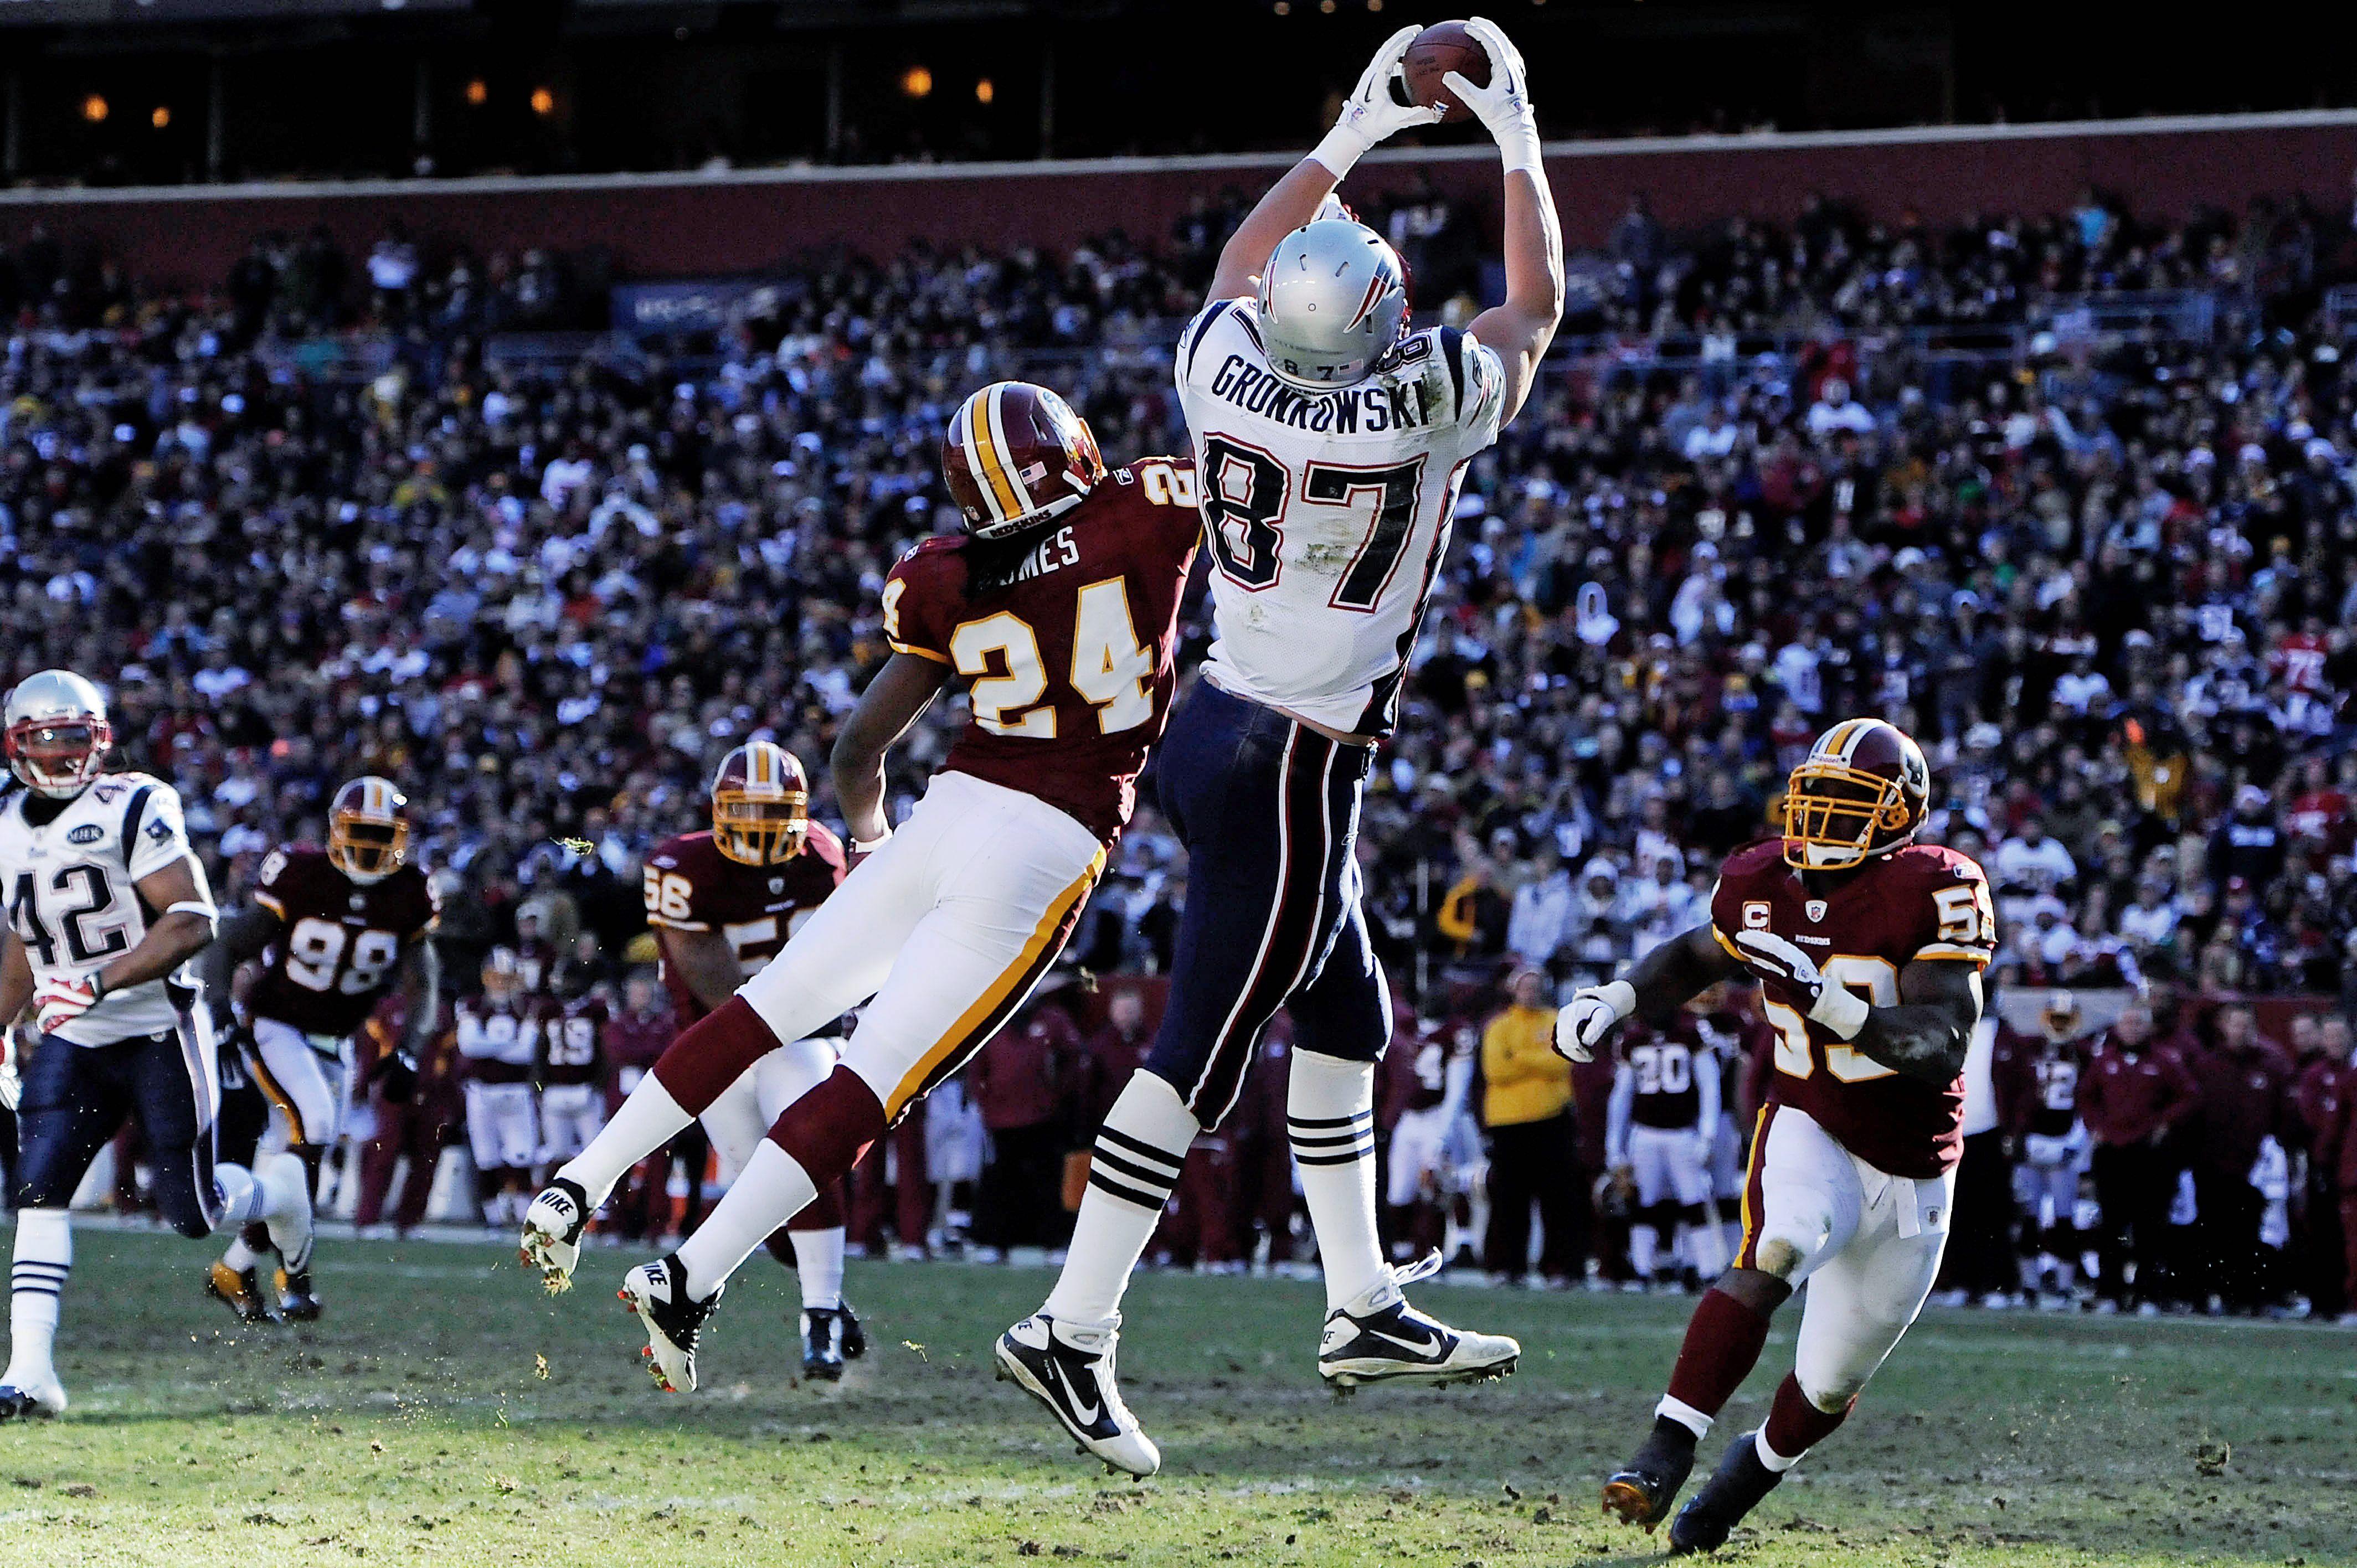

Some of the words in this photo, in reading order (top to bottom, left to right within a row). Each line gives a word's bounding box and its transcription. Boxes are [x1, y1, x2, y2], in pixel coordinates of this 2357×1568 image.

[1211, 354, 1429, 434] GRONKOWSKI
[1202, 431, 1430, 613] 87
[949, 574, 1154, 739] 24
[9, 858, 133, 968] 42
[1744, 904, 1769, 928] C
[285, 916, 399, 996] 98
[536, 1192, 574, 1216] NIKE
[642, 1261, 668, 1286] IKE
